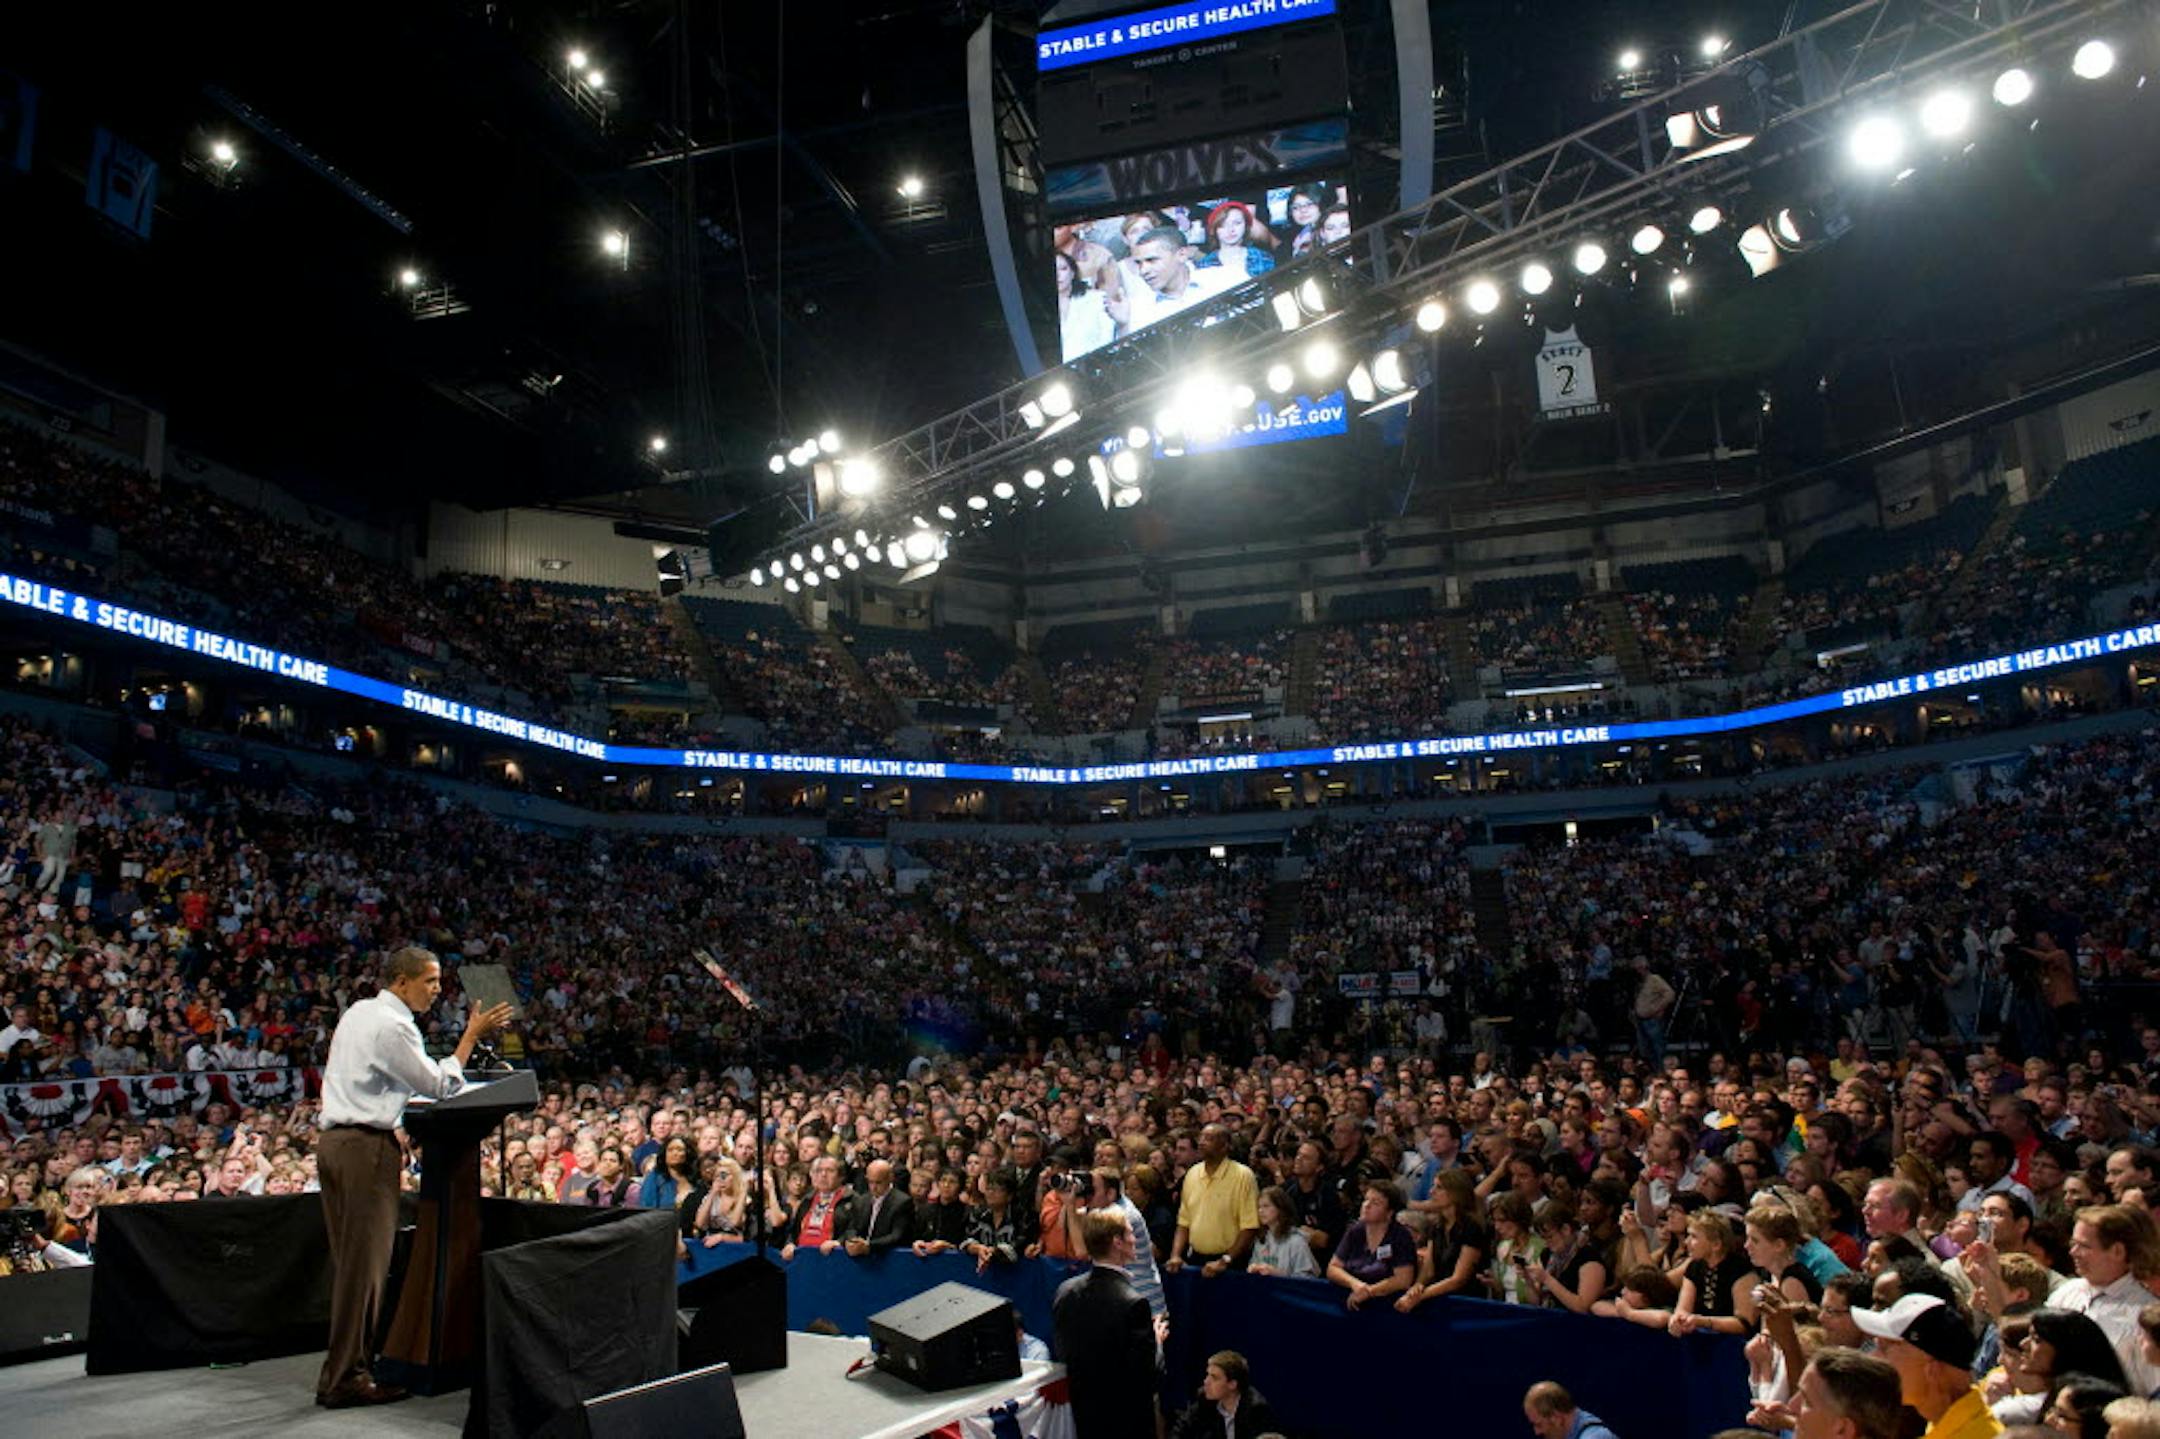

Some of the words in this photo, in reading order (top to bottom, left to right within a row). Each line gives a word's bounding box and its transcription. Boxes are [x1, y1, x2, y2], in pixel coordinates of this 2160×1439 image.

[1040, 31, 1106, 58] STABLE
[1112, 27, 1123, 44] &
[1129, 13, 1199, 39] SECURE
[1205, 0, 1276, 25] HEALTH
[1555, 364, 1576, 396] 2
[72, 596, 90, 622] &
[97, 602, 189, 648] SECURE
[195, 630, 274, 672] HEALTH
[280, 654, 329, 685] CARE
[1842, 677, 1911, 707] STABLE
[1916, 674, 1930, 692] &
[1935, 655, 2012, 688] SECURE
[2016, 638, 2101, 671] HEALTH
[2107, 623, 2160, 652] CARE
[402, 689, 458, 721] STABLE
[461, 705, 473, 726] &
[475, 709, 527, 740] SECURE
[528, 722, 575, 753] HEALTH
[576, 736, 608, 760] CARE
[1333, 743, 1397, 763] STABLE
[1402, 741, 1414, 757] &
[1417, 736, 1485, 755] SECURE
[1489, 729, 1558, 750] HEALTH
[1562, 726, 1610, 745] CARE
[684, 750, 749, 769] STABLE
[755, 754, 767, 770] &
[771, 755, 836, 773] SECURE
[840, 758, 902, 776] HEALTH
[905, 761, 946, 778] CARE
[1012, 767, 1066, 783] STABLE
[1069, 768, 1081, 783] &
[1085, 763, 1146, 782] SECURE
[1149, 757, 1210, 777] HEALTH
[1215, 754, 1258, 772] CARE
